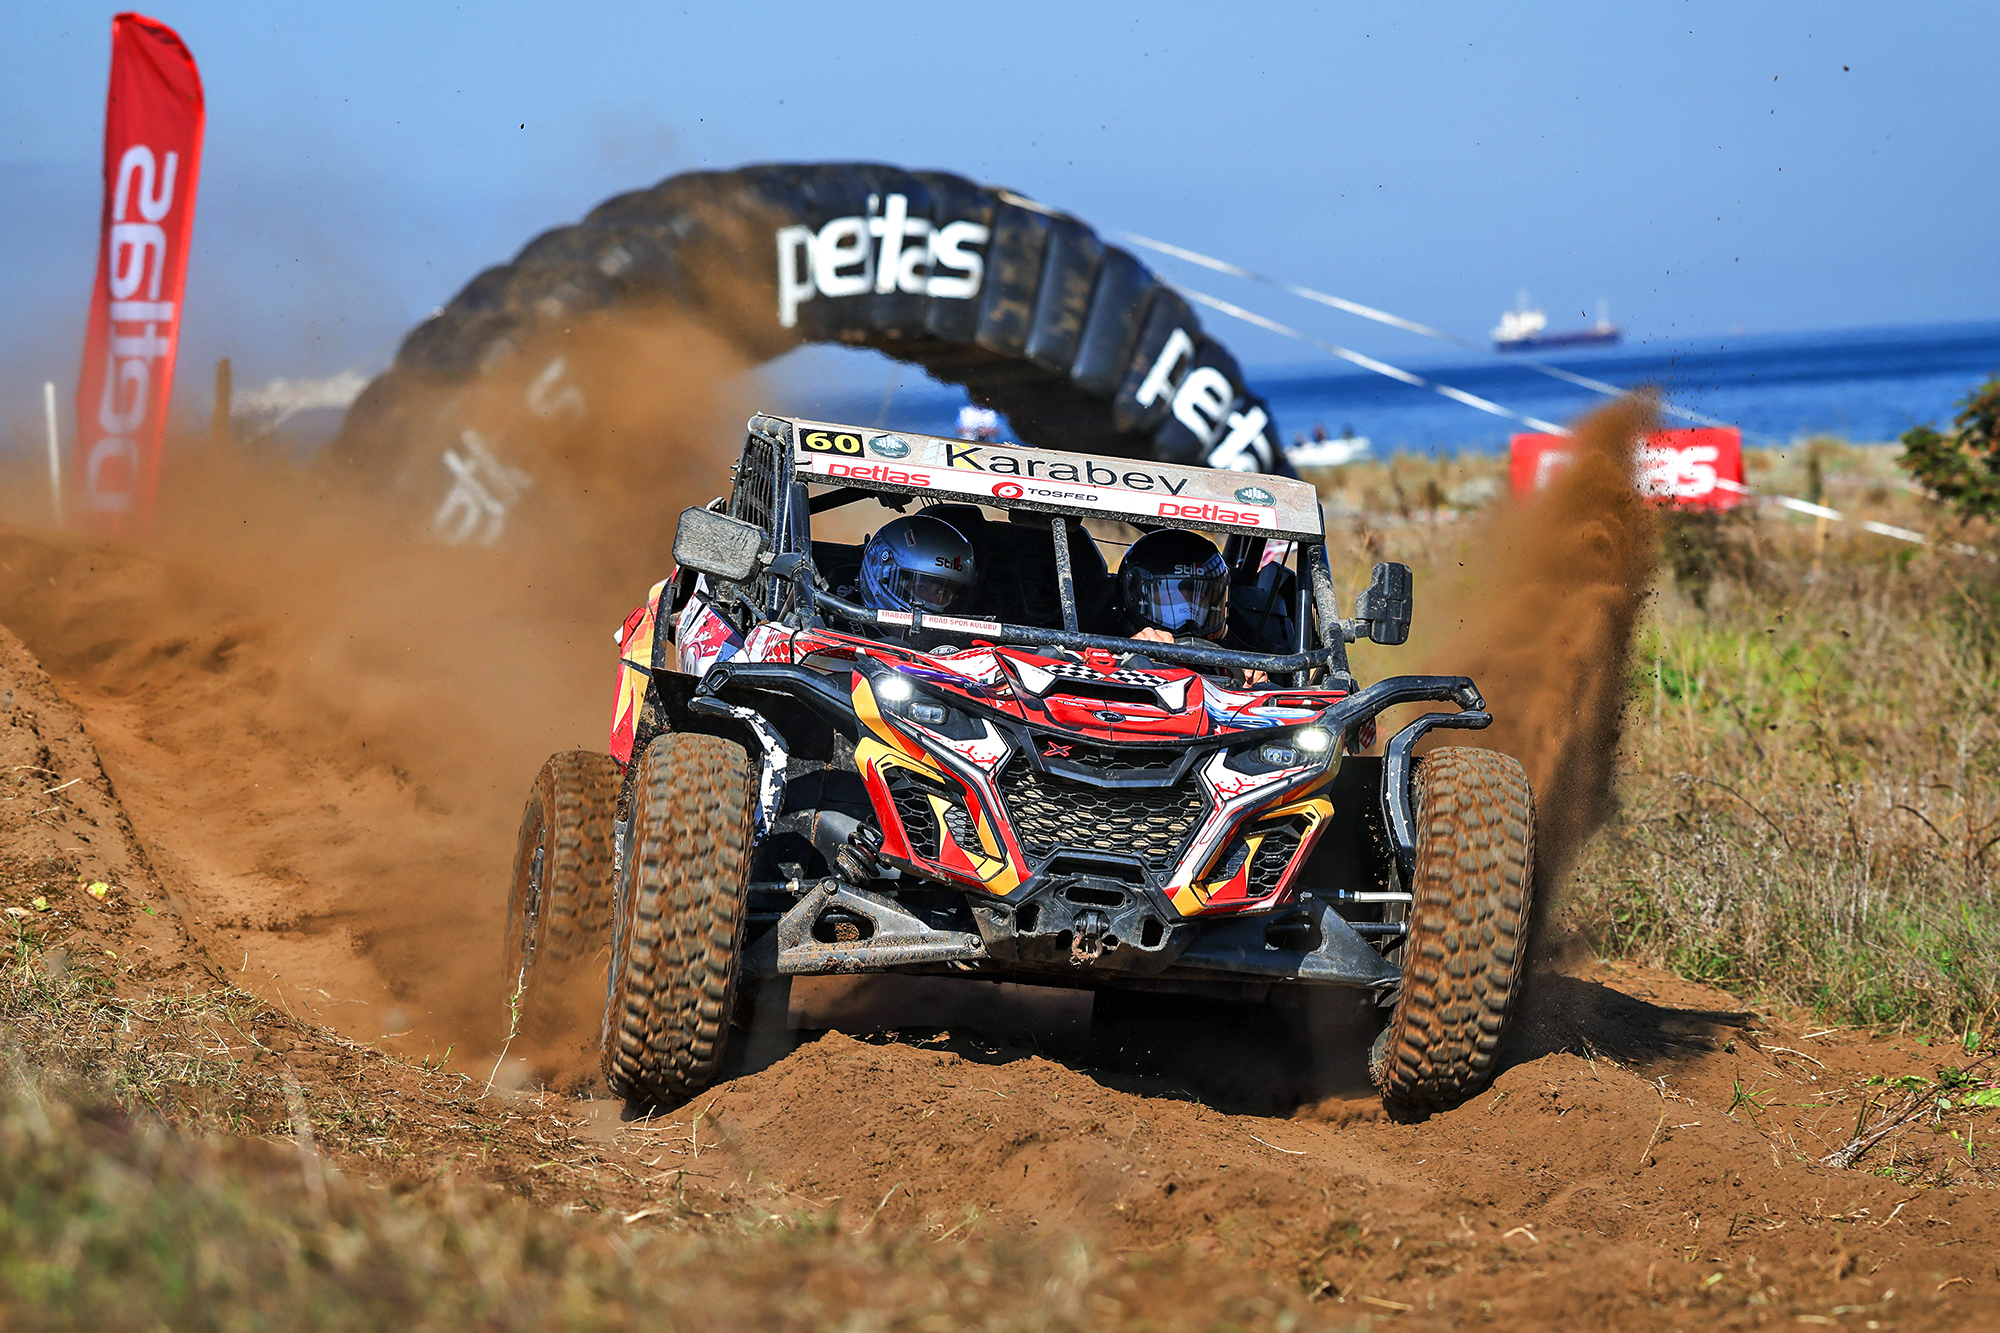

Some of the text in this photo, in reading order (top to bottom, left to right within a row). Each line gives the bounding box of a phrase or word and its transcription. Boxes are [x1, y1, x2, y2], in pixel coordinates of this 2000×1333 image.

[805, 432, 861, 453] 60
[828, 463, 931, 487] petlas
[945, 443, 1189, 496] Karabey
[1027, 487, 1099, 502] TOSFED
[1158, 502, 1260, 526] petlas
[935, 556, 963, 572] Stilo
[1174, 562, 1205, 576] Stilo
[928, 617, 948, 625] ROAD
